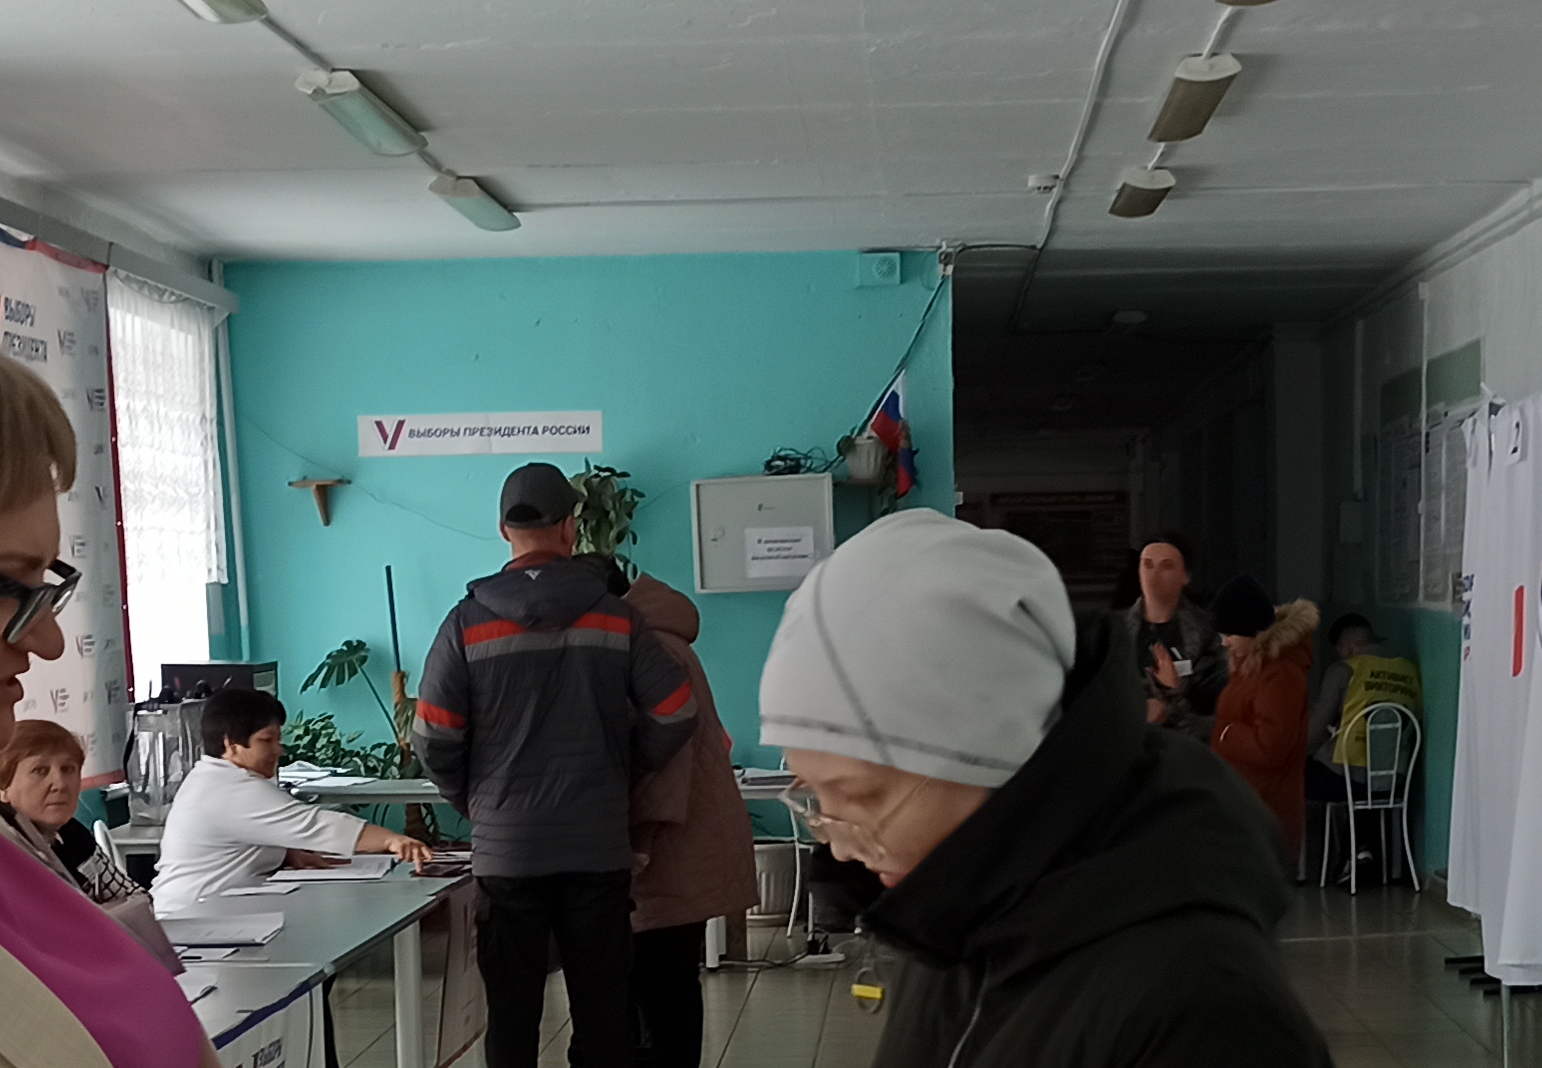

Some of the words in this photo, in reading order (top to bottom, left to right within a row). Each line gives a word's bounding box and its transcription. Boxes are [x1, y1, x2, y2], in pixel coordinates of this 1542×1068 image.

[3, 296, 37, 328] ВЫБОРЫ
[408, 427, 461, 439] ВЫБОРЫ
[463, 425, 539, 438] ПРЕЗИДЕНТА
[541, 424, 591, 436] РОССИИ
